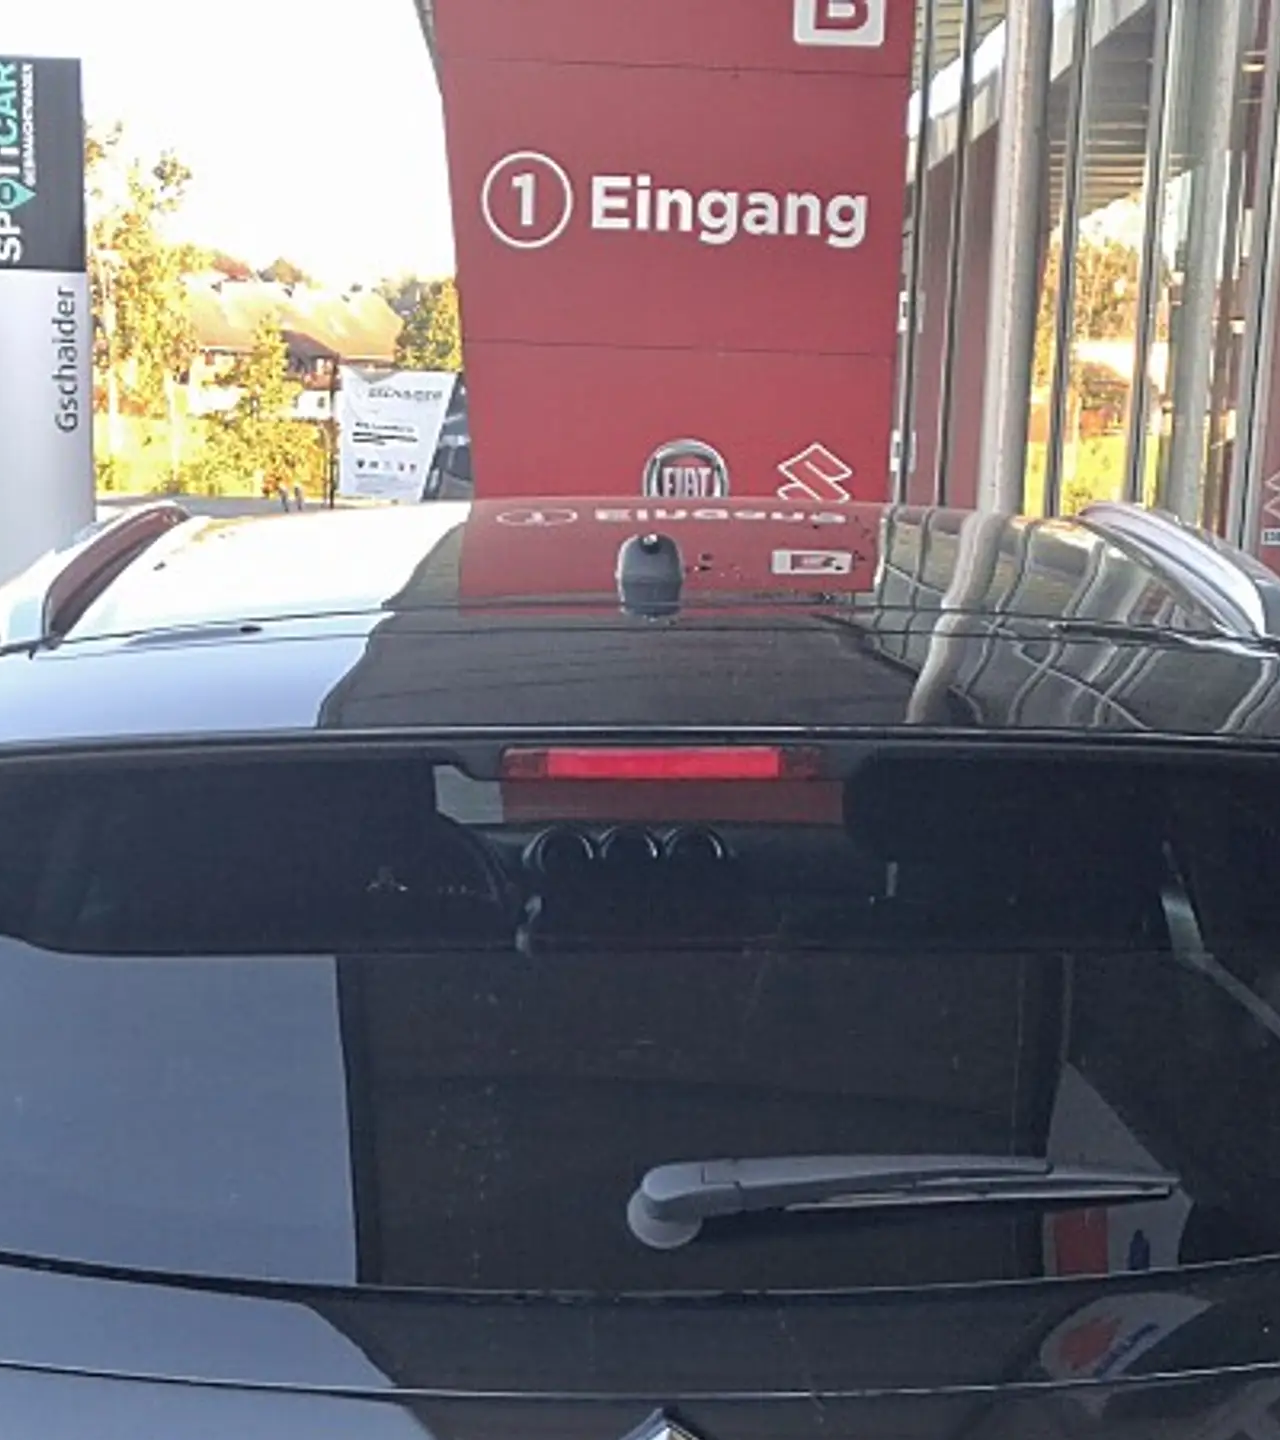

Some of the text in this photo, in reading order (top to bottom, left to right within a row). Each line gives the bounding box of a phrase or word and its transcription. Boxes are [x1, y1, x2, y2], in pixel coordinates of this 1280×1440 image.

[510, 173, 869, 249] 1 Eingang
[51, 285, 79, 433] Gschaider
[661, 466, 713, 497] FIAT
